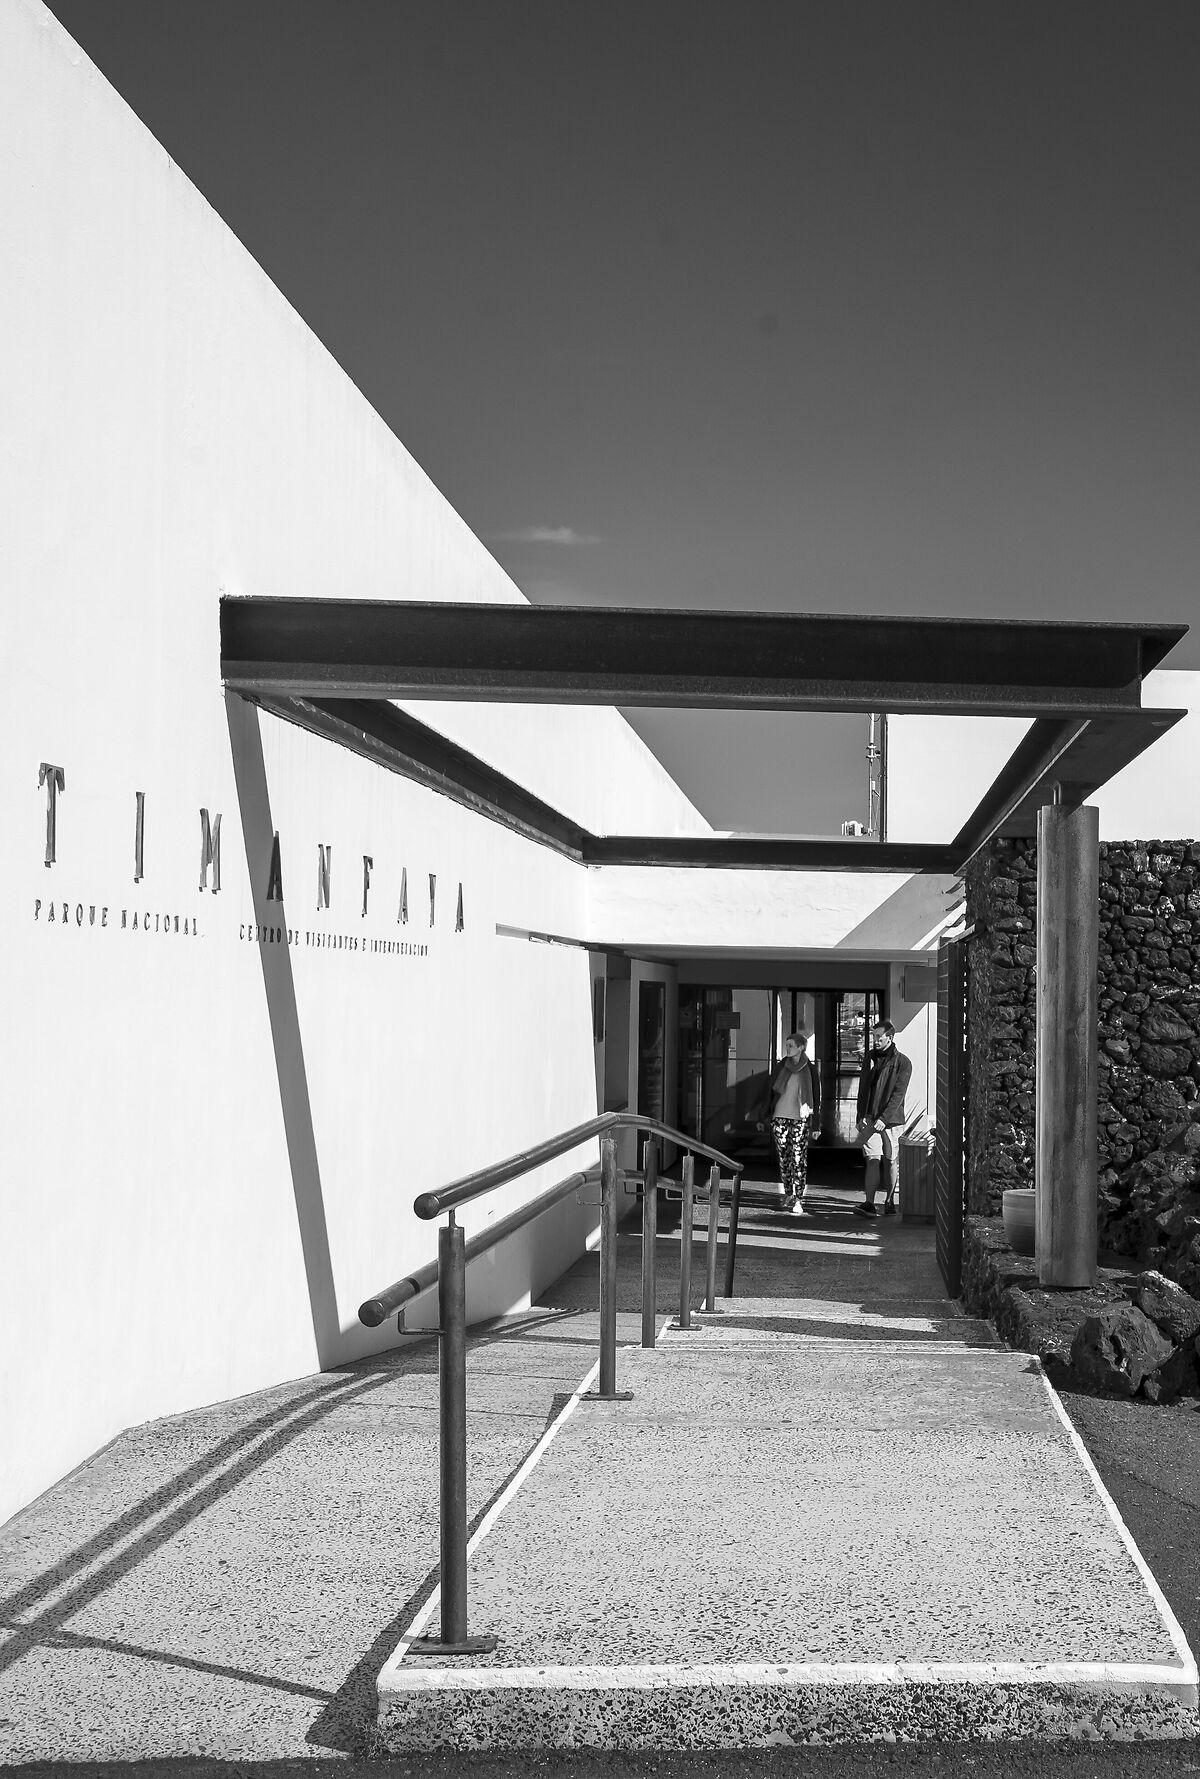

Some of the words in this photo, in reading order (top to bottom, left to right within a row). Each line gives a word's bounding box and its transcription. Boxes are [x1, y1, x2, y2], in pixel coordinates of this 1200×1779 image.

[38, 762, 465, 932] TIMANFAYA
[34, 899, 108, 927] PARQUE
[121, 909, 198, 936] NACIONAL
[240, 924, 282, 943] CENTRO
[287, 929, 299, 945] DE
[306, 931, 358, 950] VISITANTES
[362, 938, 366, 951] E
